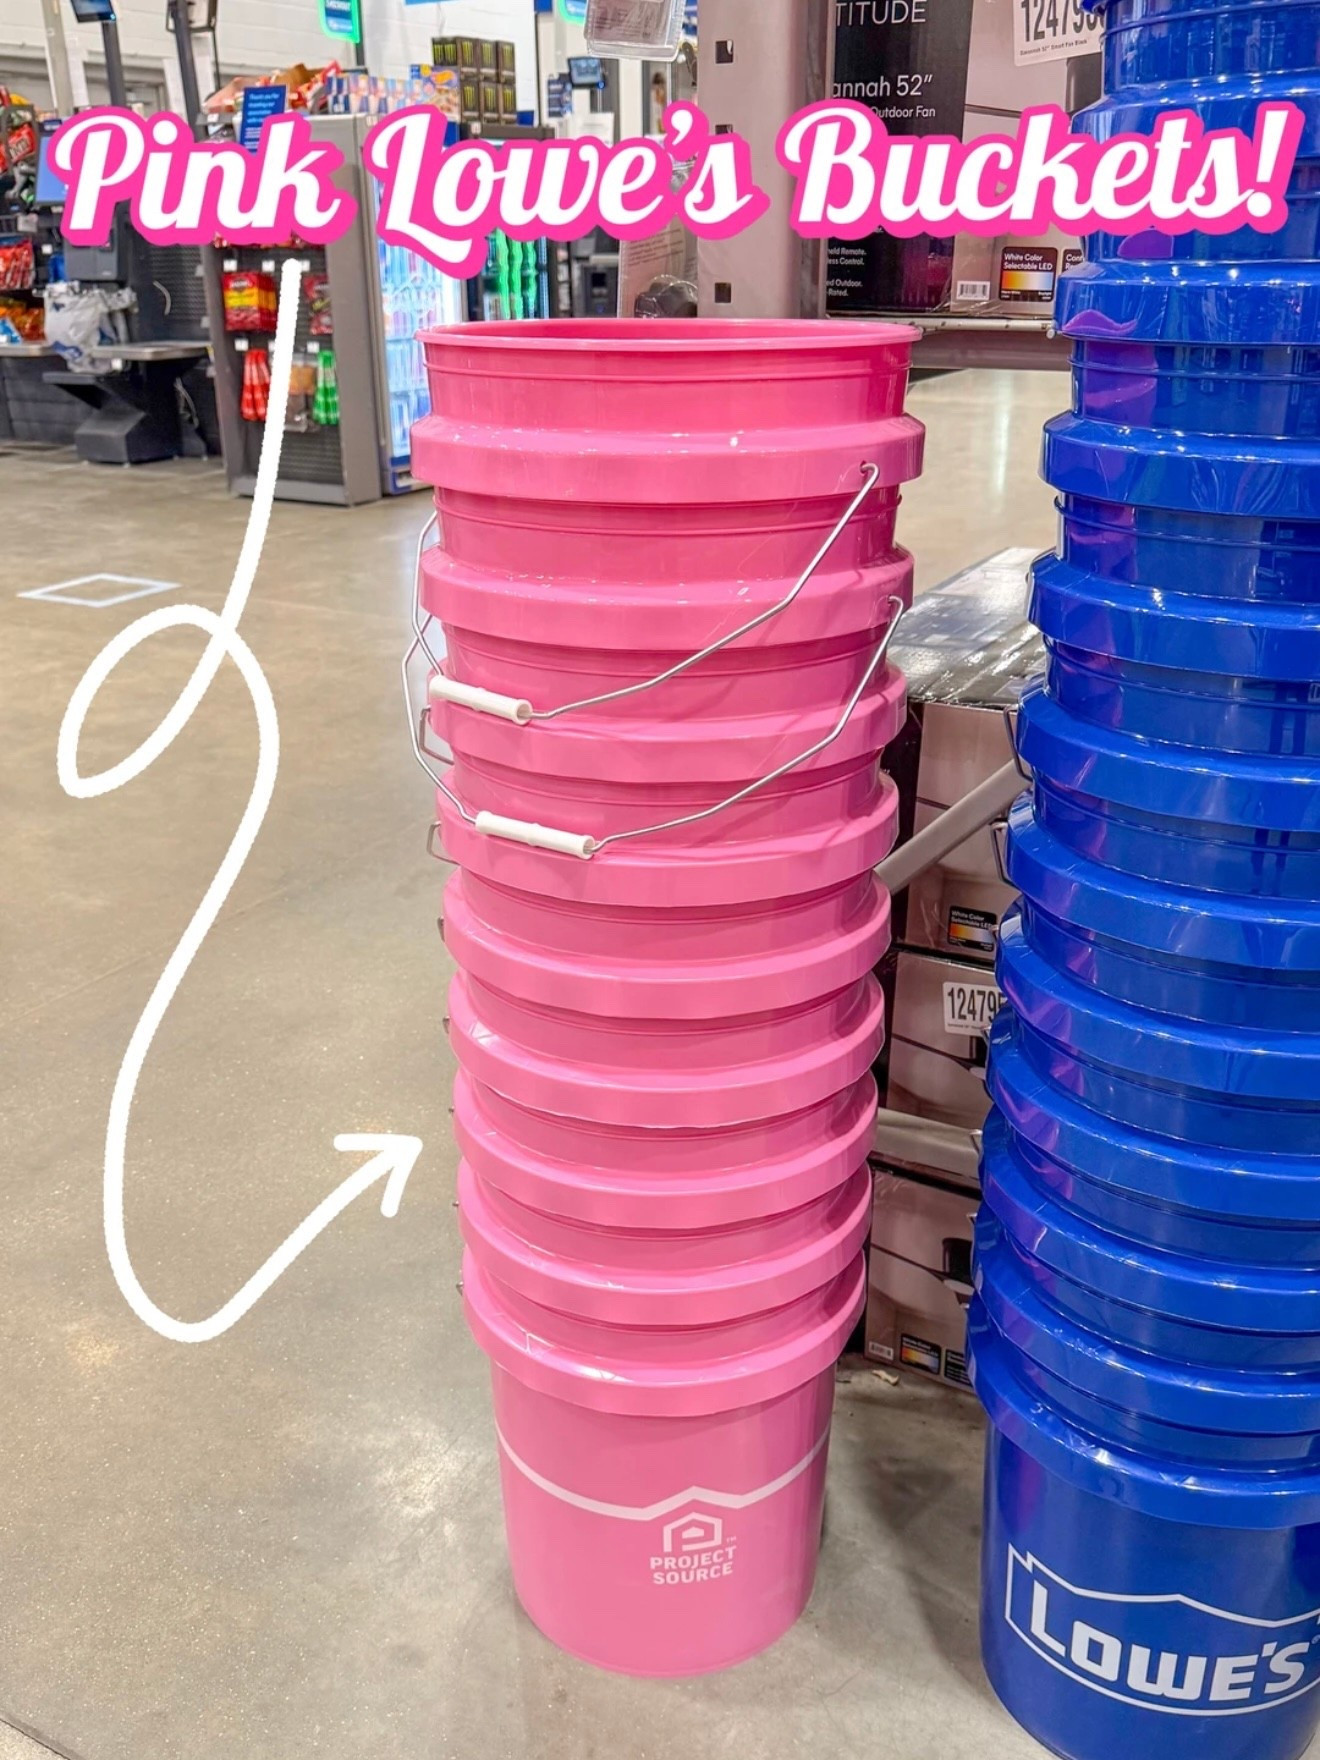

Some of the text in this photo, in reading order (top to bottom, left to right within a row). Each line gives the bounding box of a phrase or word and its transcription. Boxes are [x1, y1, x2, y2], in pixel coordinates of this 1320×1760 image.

[915, 105, 936, 118] Fan
[1003, 261, 1053, 270] Selectable LED
[1004, 253, 1043, 261] White Color
[650, 1545, 737, 1570] PROJECT
[653, 1561, 733, 1585] SOURCE
[1030, 1579, 1310, 1702] LOWE'S
